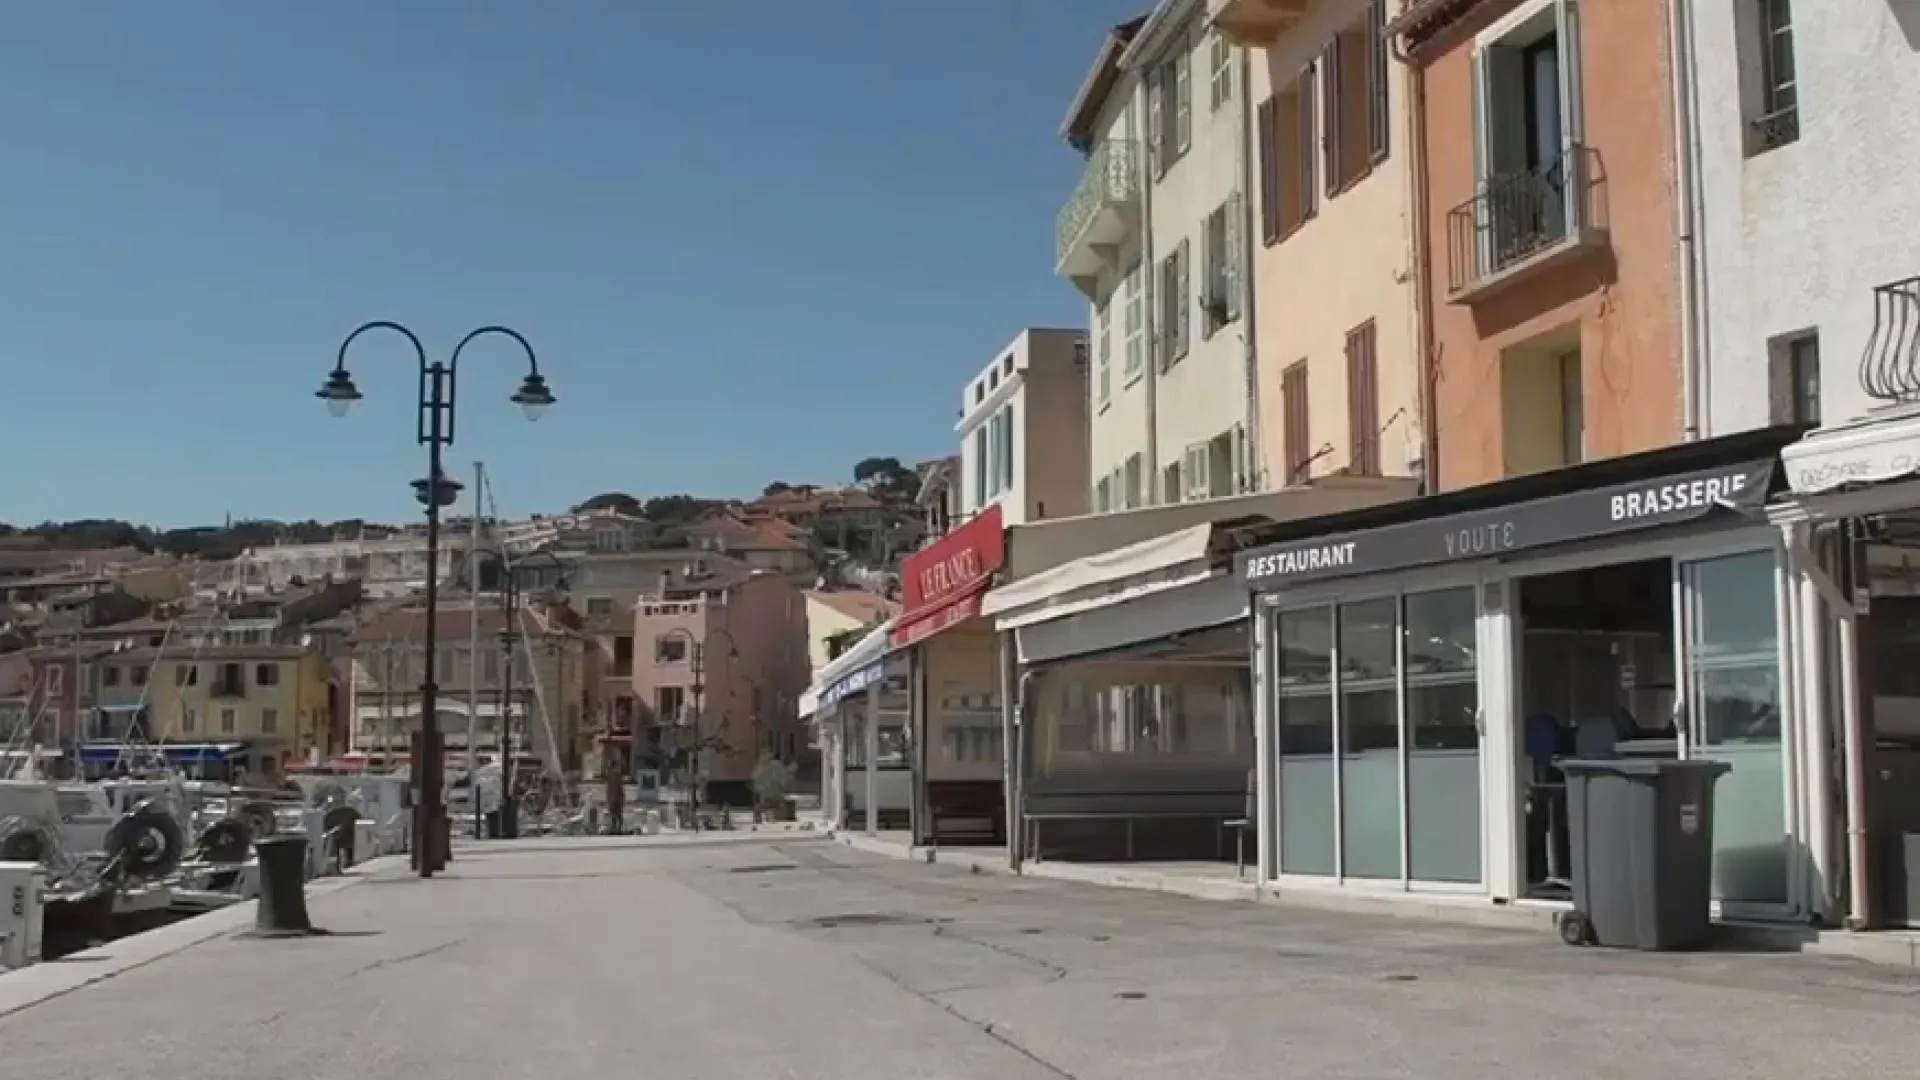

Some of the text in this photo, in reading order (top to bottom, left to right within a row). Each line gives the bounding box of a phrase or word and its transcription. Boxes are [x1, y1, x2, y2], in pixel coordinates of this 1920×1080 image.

[1246, 473, 1746, 578] RESTAURANT VOUTE BRASSERIE
